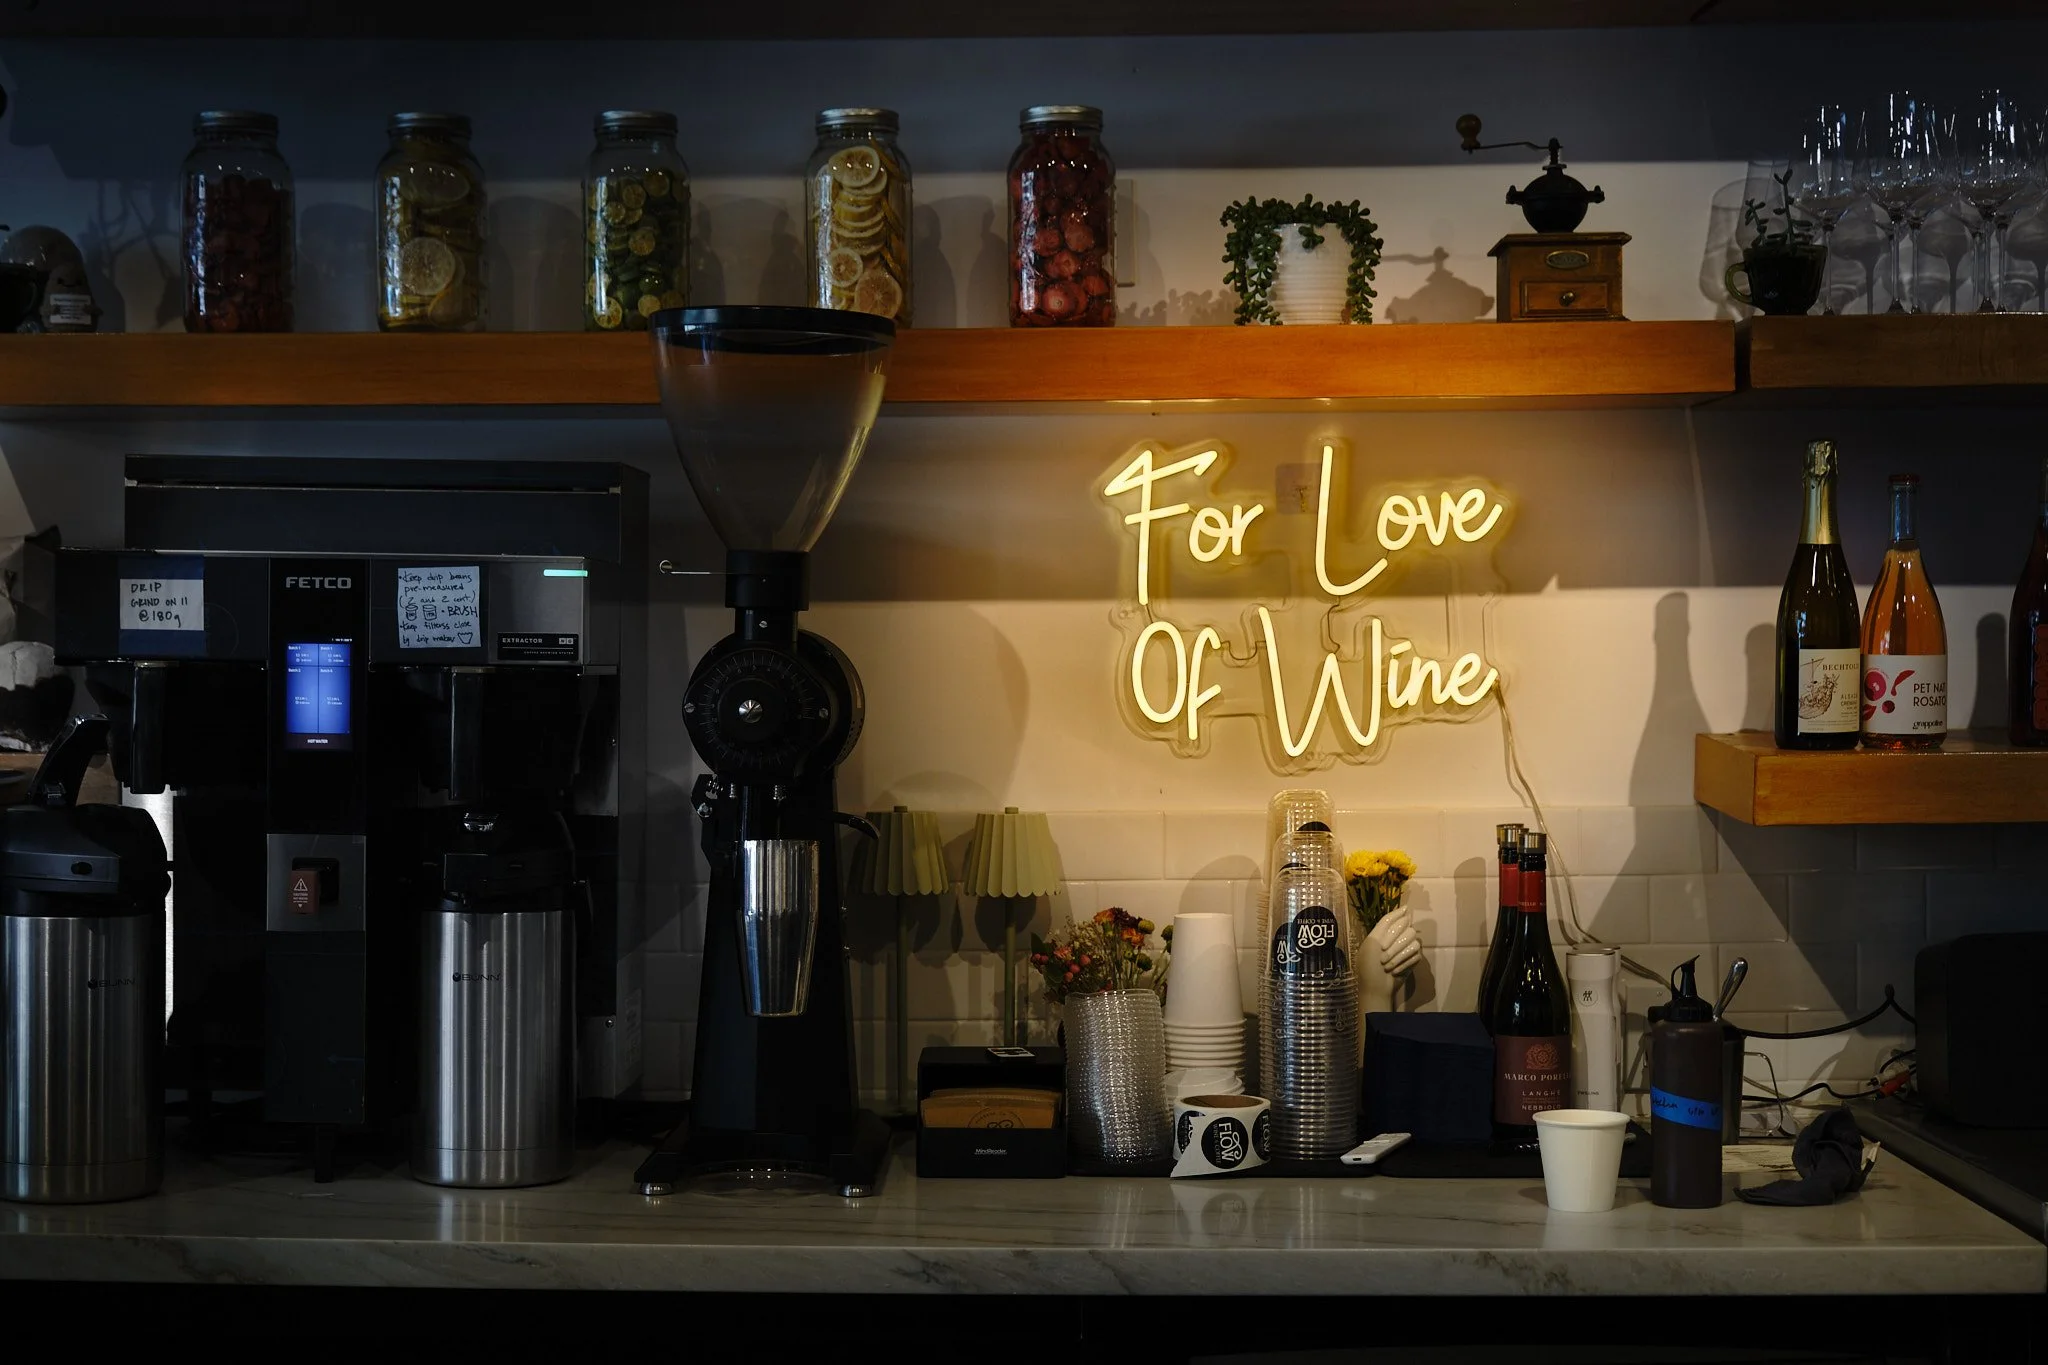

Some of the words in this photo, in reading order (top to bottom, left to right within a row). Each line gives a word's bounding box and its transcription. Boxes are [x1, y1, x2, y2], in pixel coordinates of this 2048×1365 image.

[1104, 450, 1263, 604] For
[1315, 446, 1502, 595] Love
[286, 577, 351, 589] FETCO
[427, 573, 443, 584] drip
[449, 572, 472, 583] beans
[131, 582, 161, 593] DRIP
[131, 598, 160, 607] GRIND
[166, 598, 176, 606] ON
[448, 605, 478, 618] BRUSH
[402, 621, 418, 632] Keep
[454, 621, 471, 629] close
[402, 635, 410, 646] by
[1132, 620, 1221, 739] Of
[1257, 607, 1498, 756] Wine
[1914, 683, 1931, 693] PET
[1298, 925, 1334, 948] FLOW
[99, 978, 135, 987] BUNN
[461, 973, 501, 981] BUNN
[1504, 1073, 1537, 1081] MARCO
[1219, 1123, 1243, 1161] FLOW
